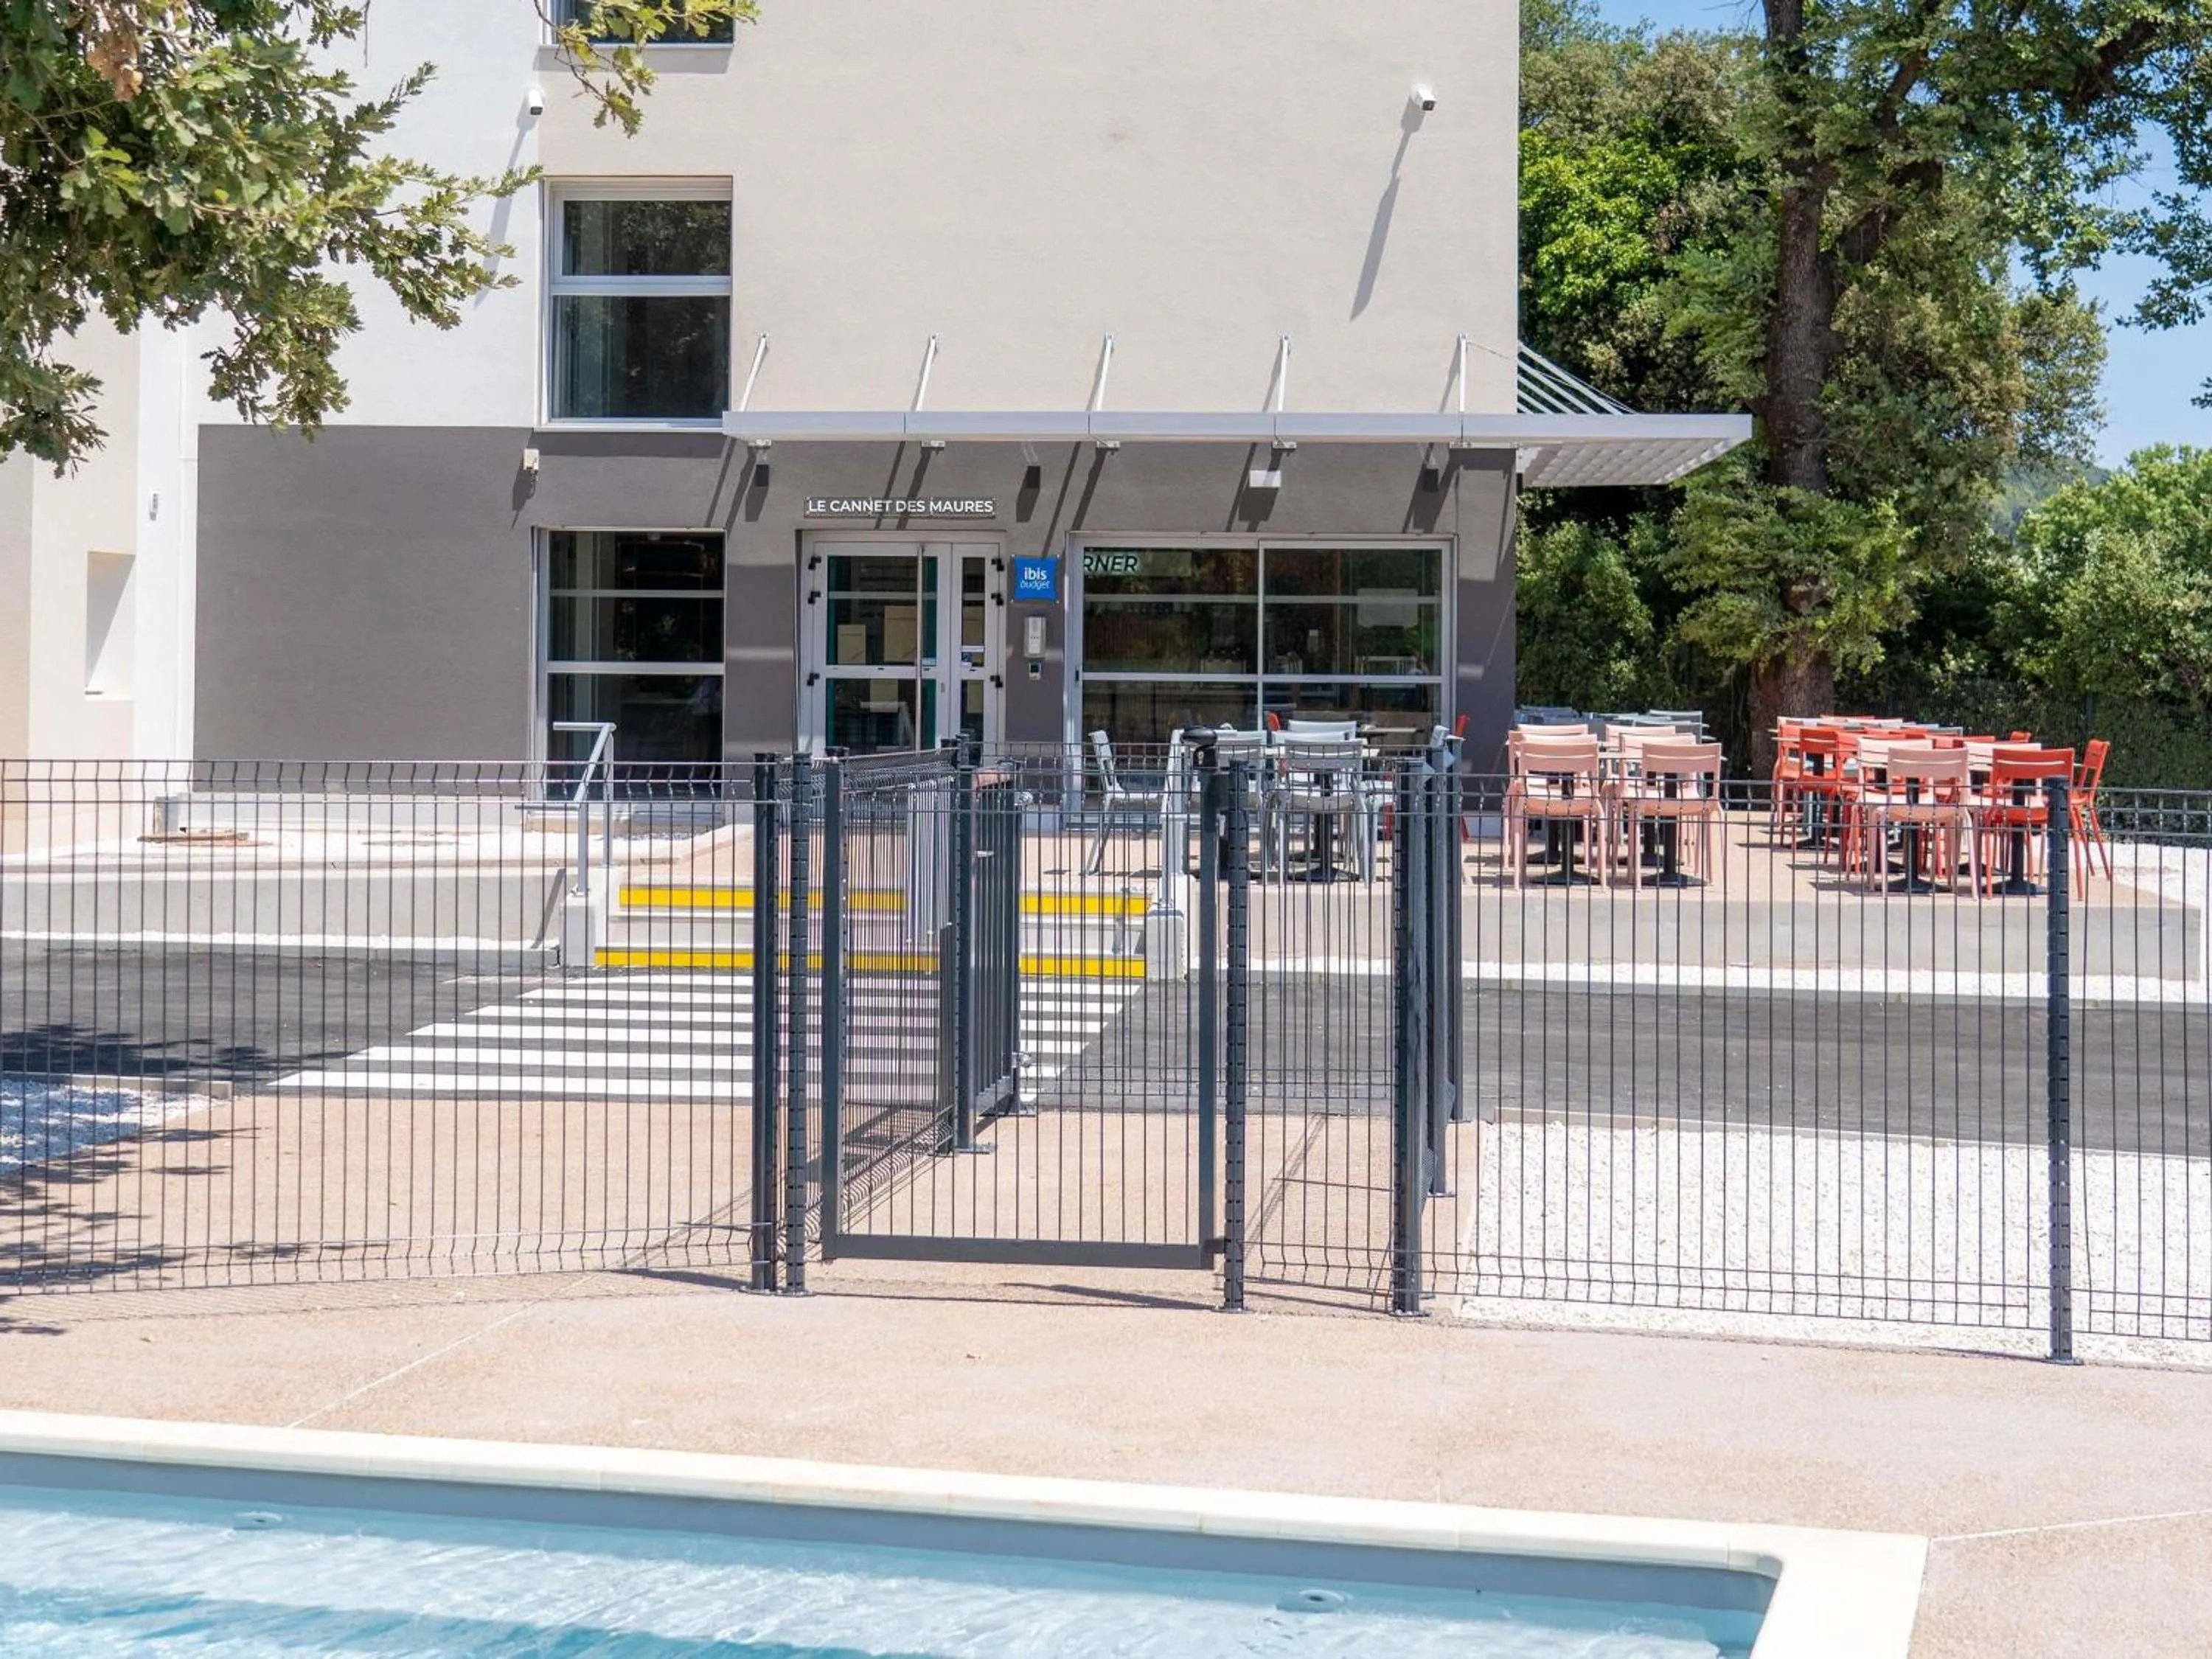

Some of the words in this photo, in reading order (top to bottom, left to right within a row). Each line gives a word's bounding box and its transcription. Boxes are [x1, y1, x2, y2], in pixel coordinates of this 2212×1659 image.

[808, 500, 827, 512] LE
[830, 500, 892, 512] CANNET
[896, 500, 925, 513] DES
[929, 500, 994, 513] MAURES
[1023, 567, 1047, 580] ibis
[1020, 580, 1051, 591] budget
